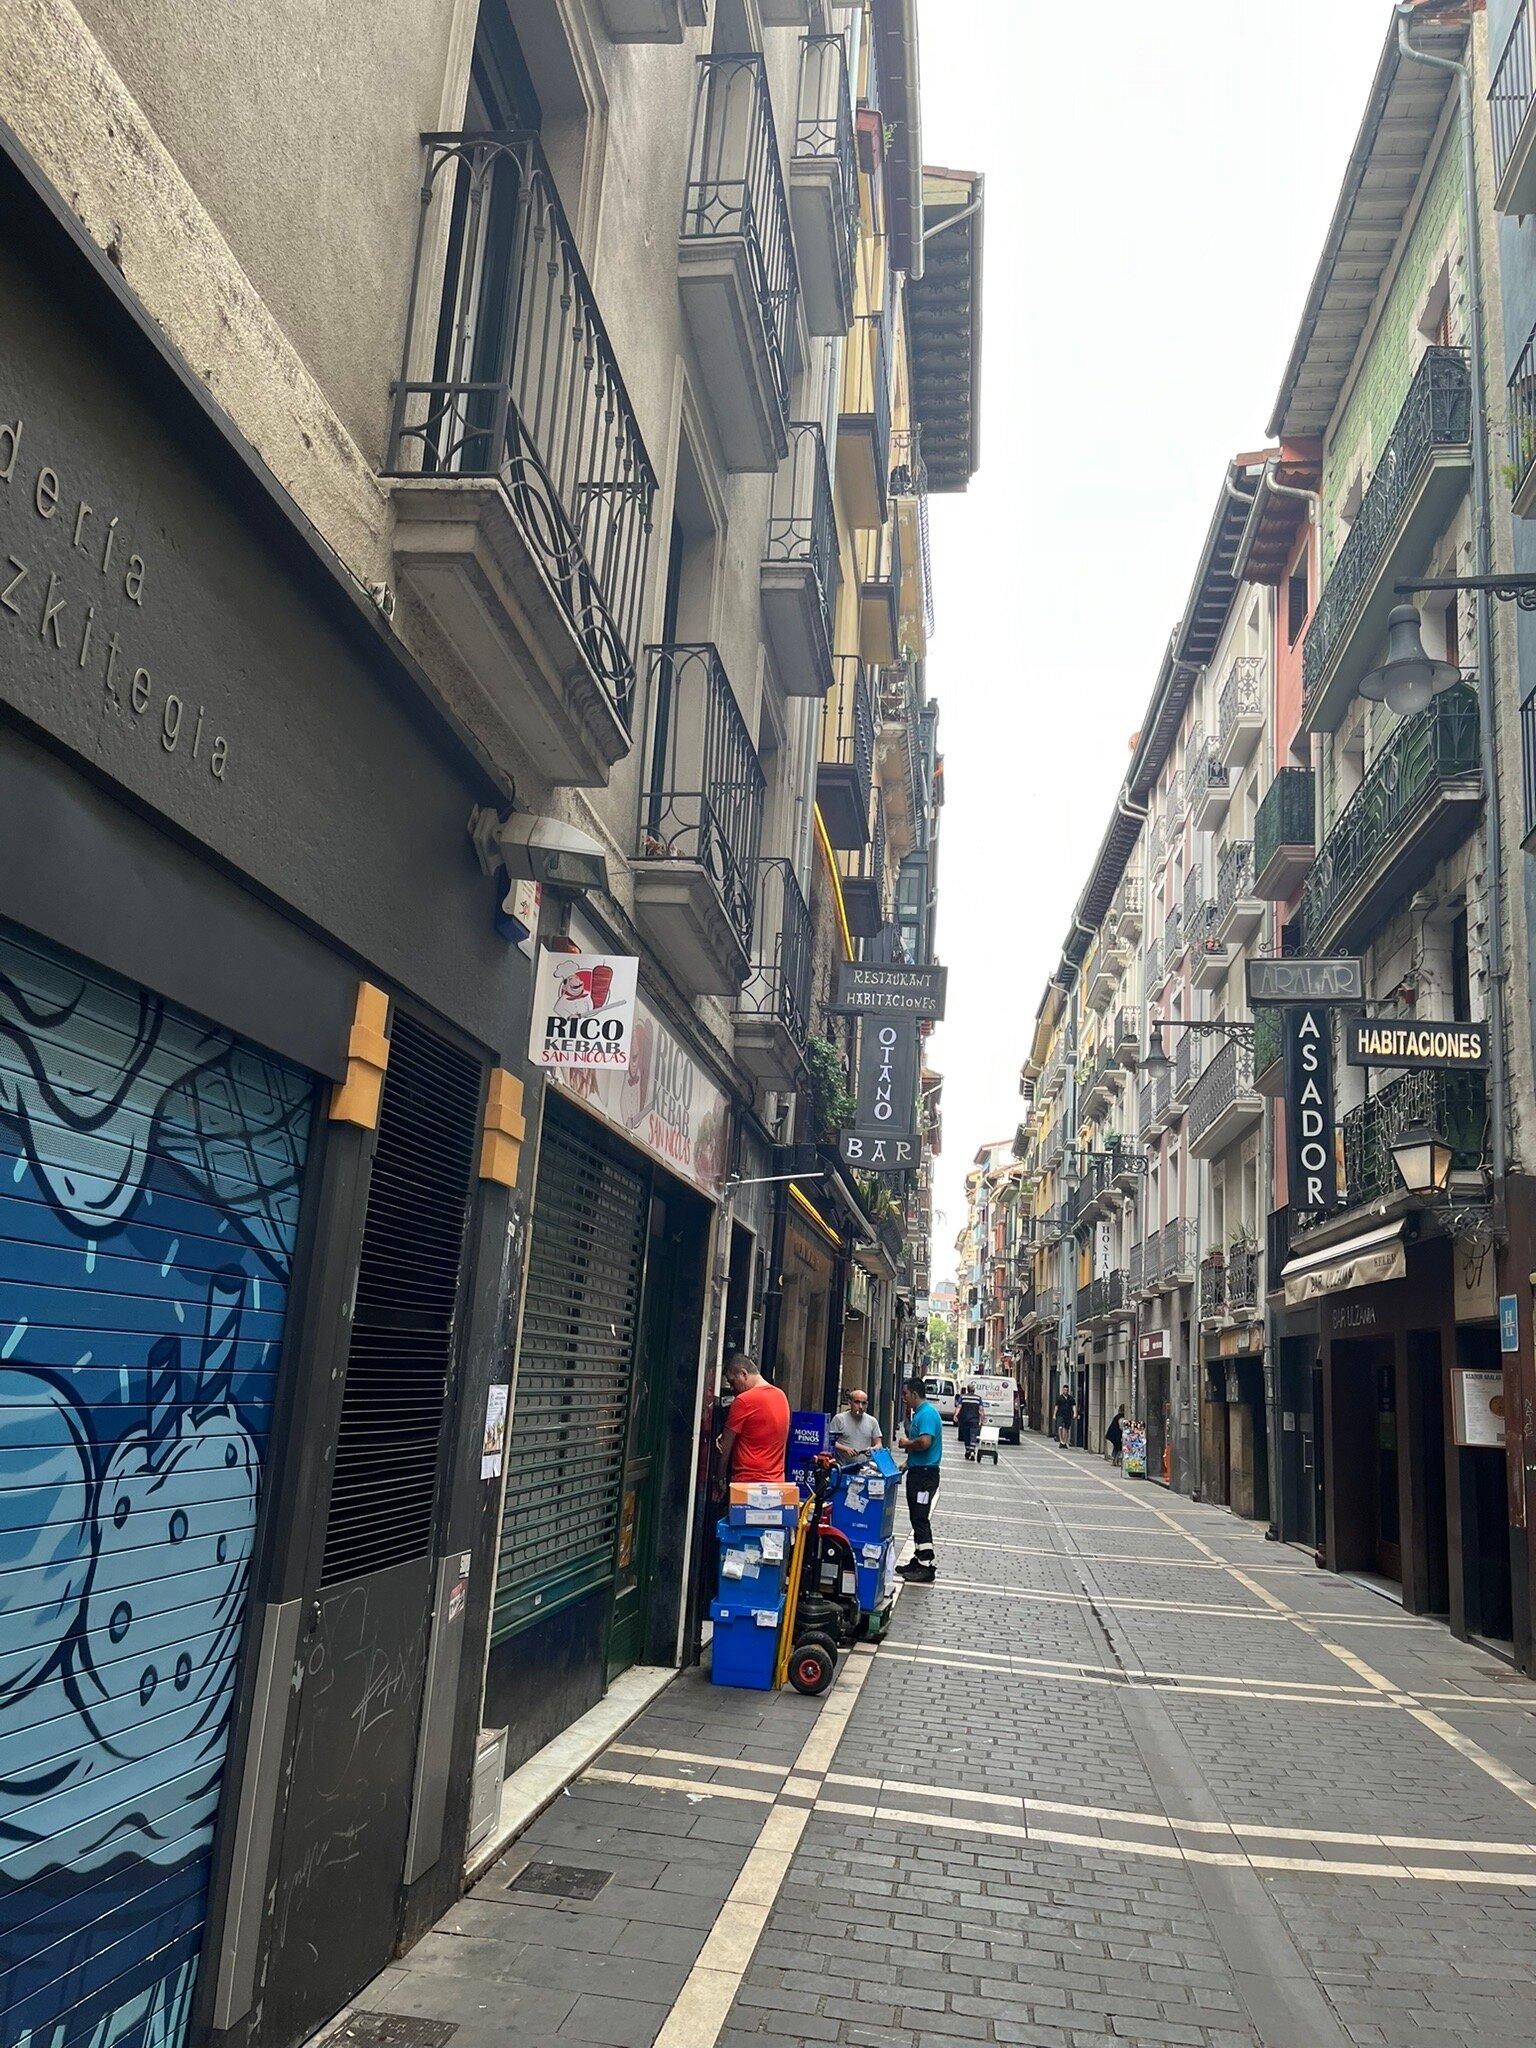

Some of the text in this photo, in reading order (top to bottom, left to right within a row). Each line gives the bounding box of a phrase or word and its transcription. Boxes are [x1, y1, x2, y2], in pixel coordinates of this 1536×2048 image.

[853, 969, 932, 987] RESTAURANT
[1259, 966, 1354, 994] ARALAR
[546, 1016, 624, 1041] RICO
[544, 1039, 621, 1054] KEBAB
[1357, 1029, 1482, 1059] HABITACIONES
[542, 1051, 627, 1064] SAN NICOLAS
[655, 1023, 694, 1111] RICO
[873, 1027, 897, 1121] OTANO
[653, 1081, 690, 1140] KEBAB
[1298, 1011, 1328, 1206] ASADOR
[846, 1137, 912, 1163] BAR
[794, 1428, 820, 1437] MONTE
[797, 1435, 820, 1443] PINOS
